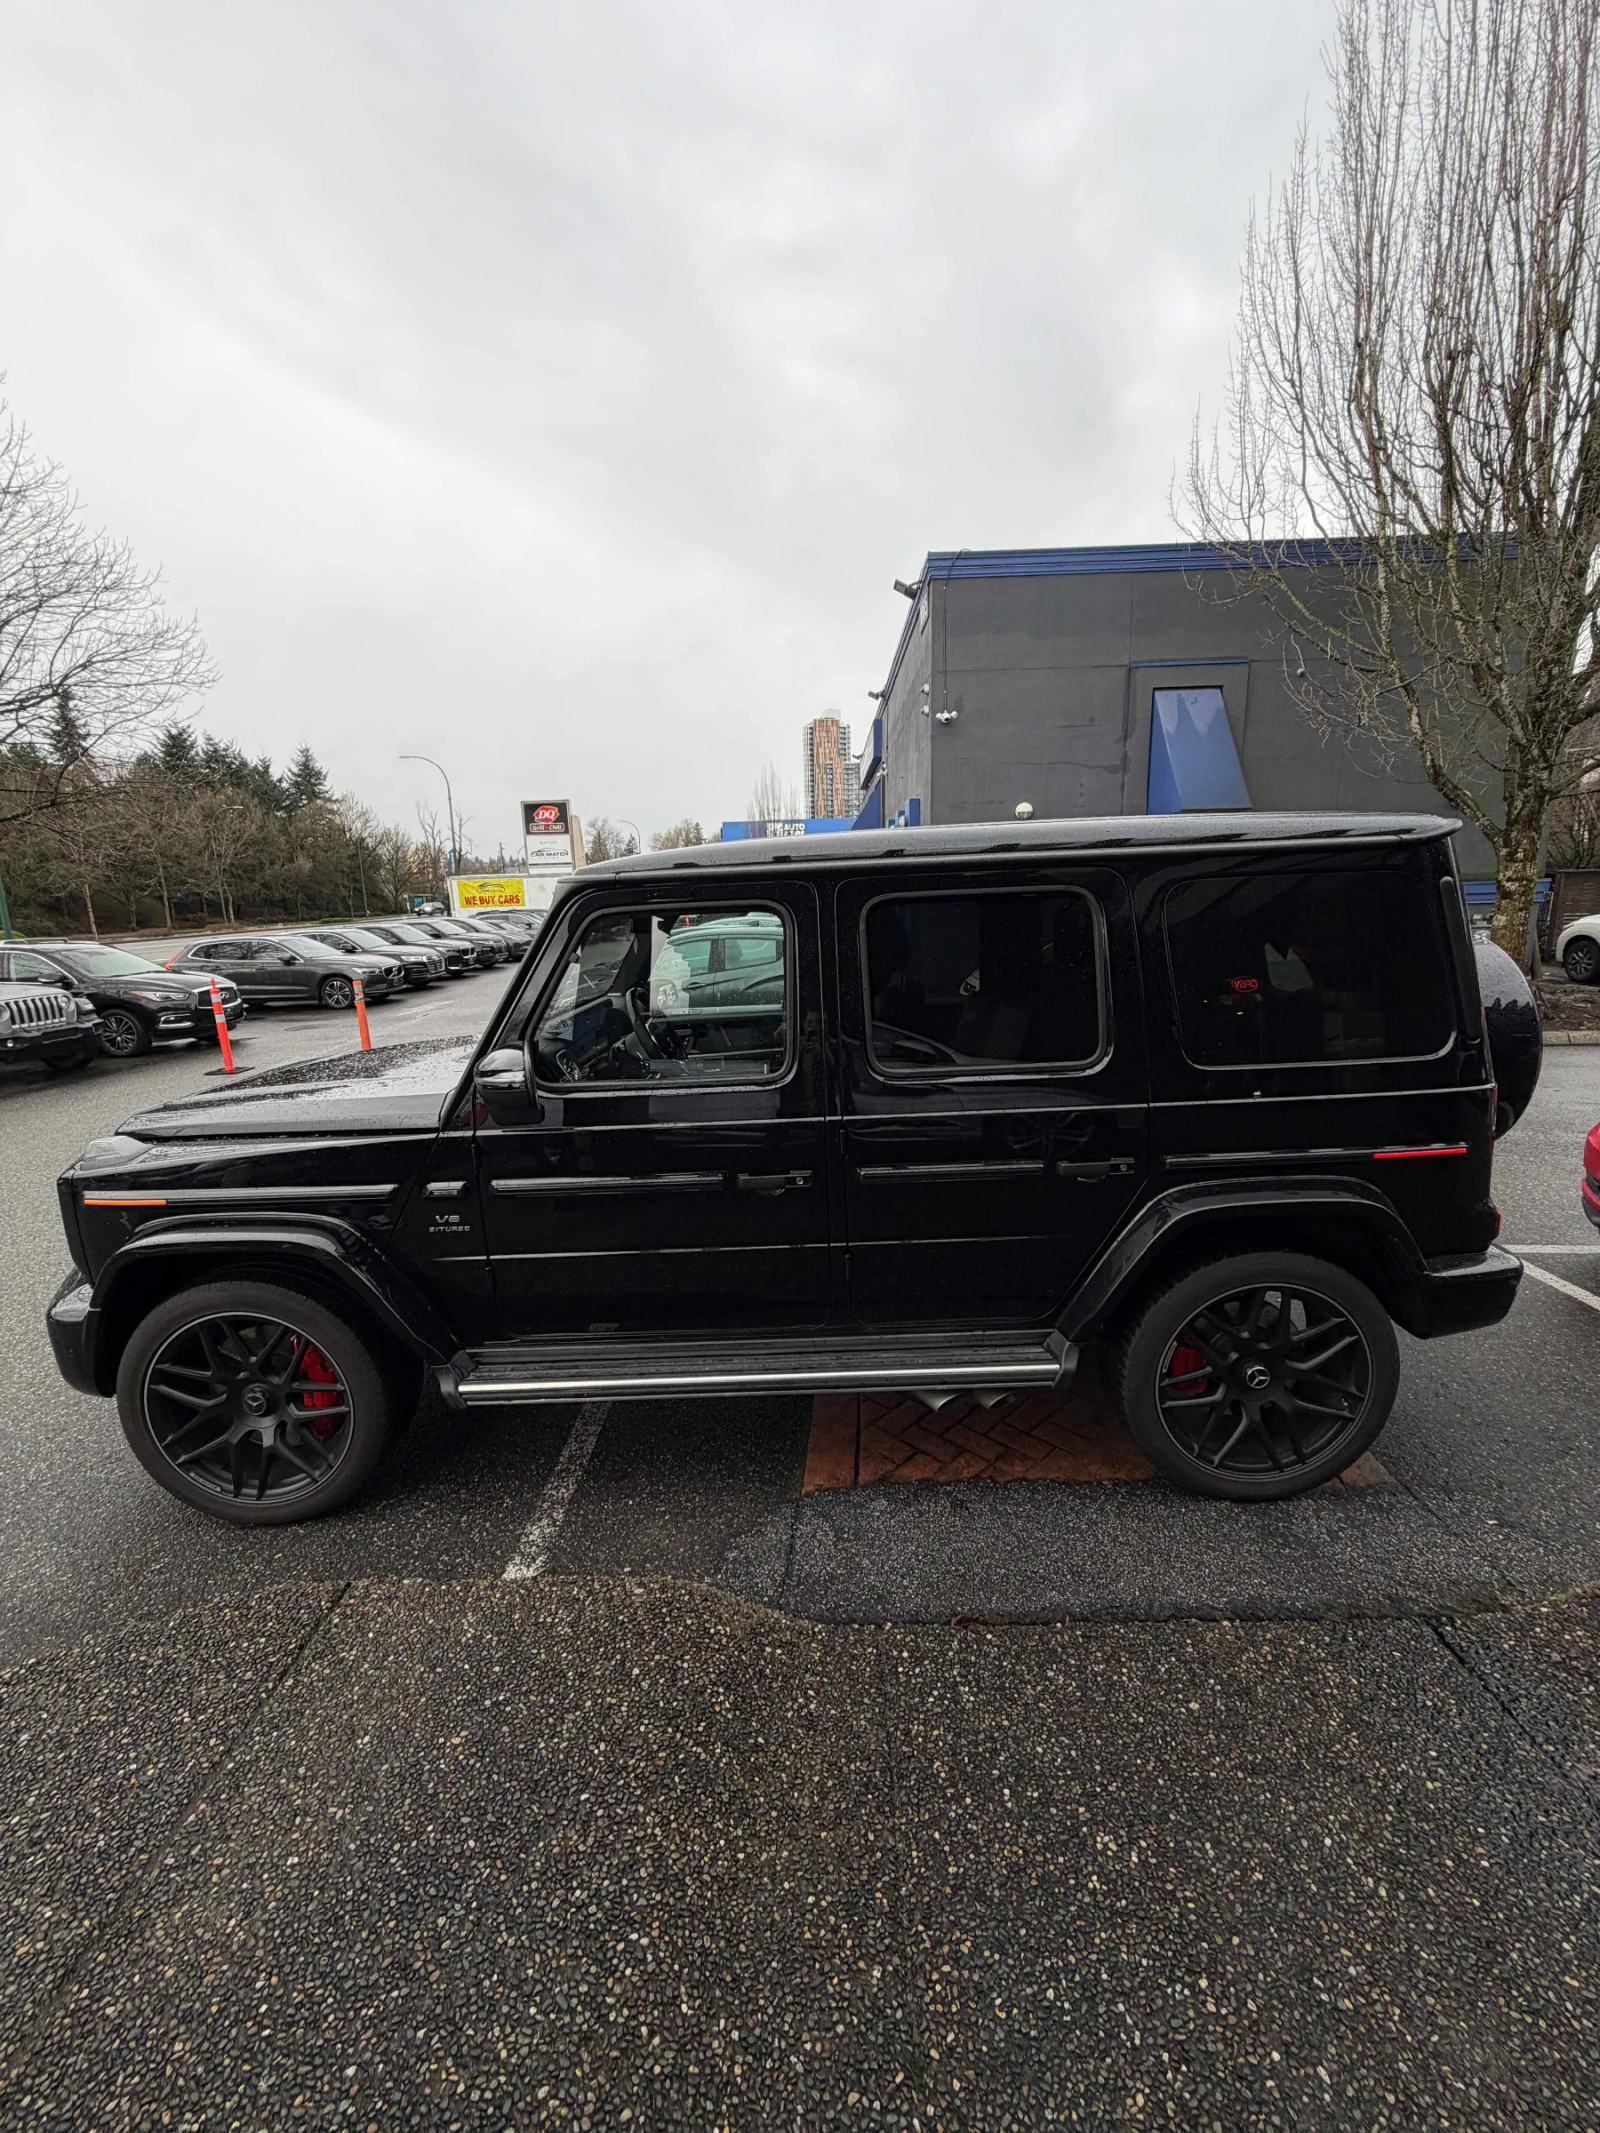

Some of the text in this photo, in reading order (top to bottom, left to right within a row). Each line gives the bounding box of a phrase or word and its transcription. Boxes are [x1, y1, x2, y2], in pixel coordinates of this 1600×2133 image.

[538, 809, 556, 820] DQ
[784, 823, 805, 831] AUTO
[464, 894, 520, 906] WE BUY CARS
